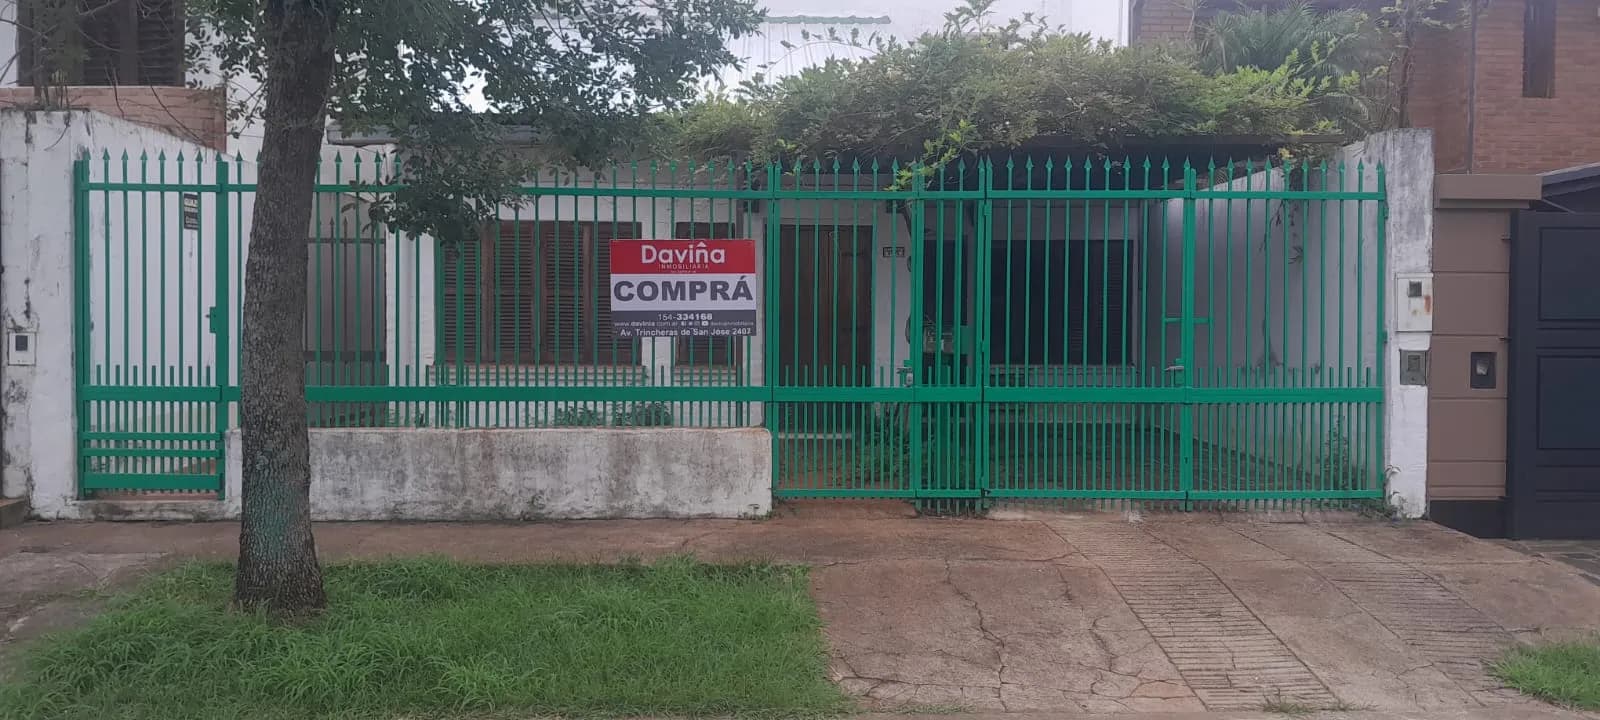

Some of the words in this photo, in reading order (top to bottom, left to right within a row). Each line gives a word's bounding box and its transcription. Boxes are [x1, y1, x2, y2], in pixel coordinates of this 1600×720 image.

[613, 275, 753, 302] COMPRÁ
[658, 313, 713, 321] 154-334168
[620, 329, 633, 337] Av.
[636, 328, 678, 336] Trincheras
[680, 328, 691, 336] de
[693, 328, 708, 336] San
